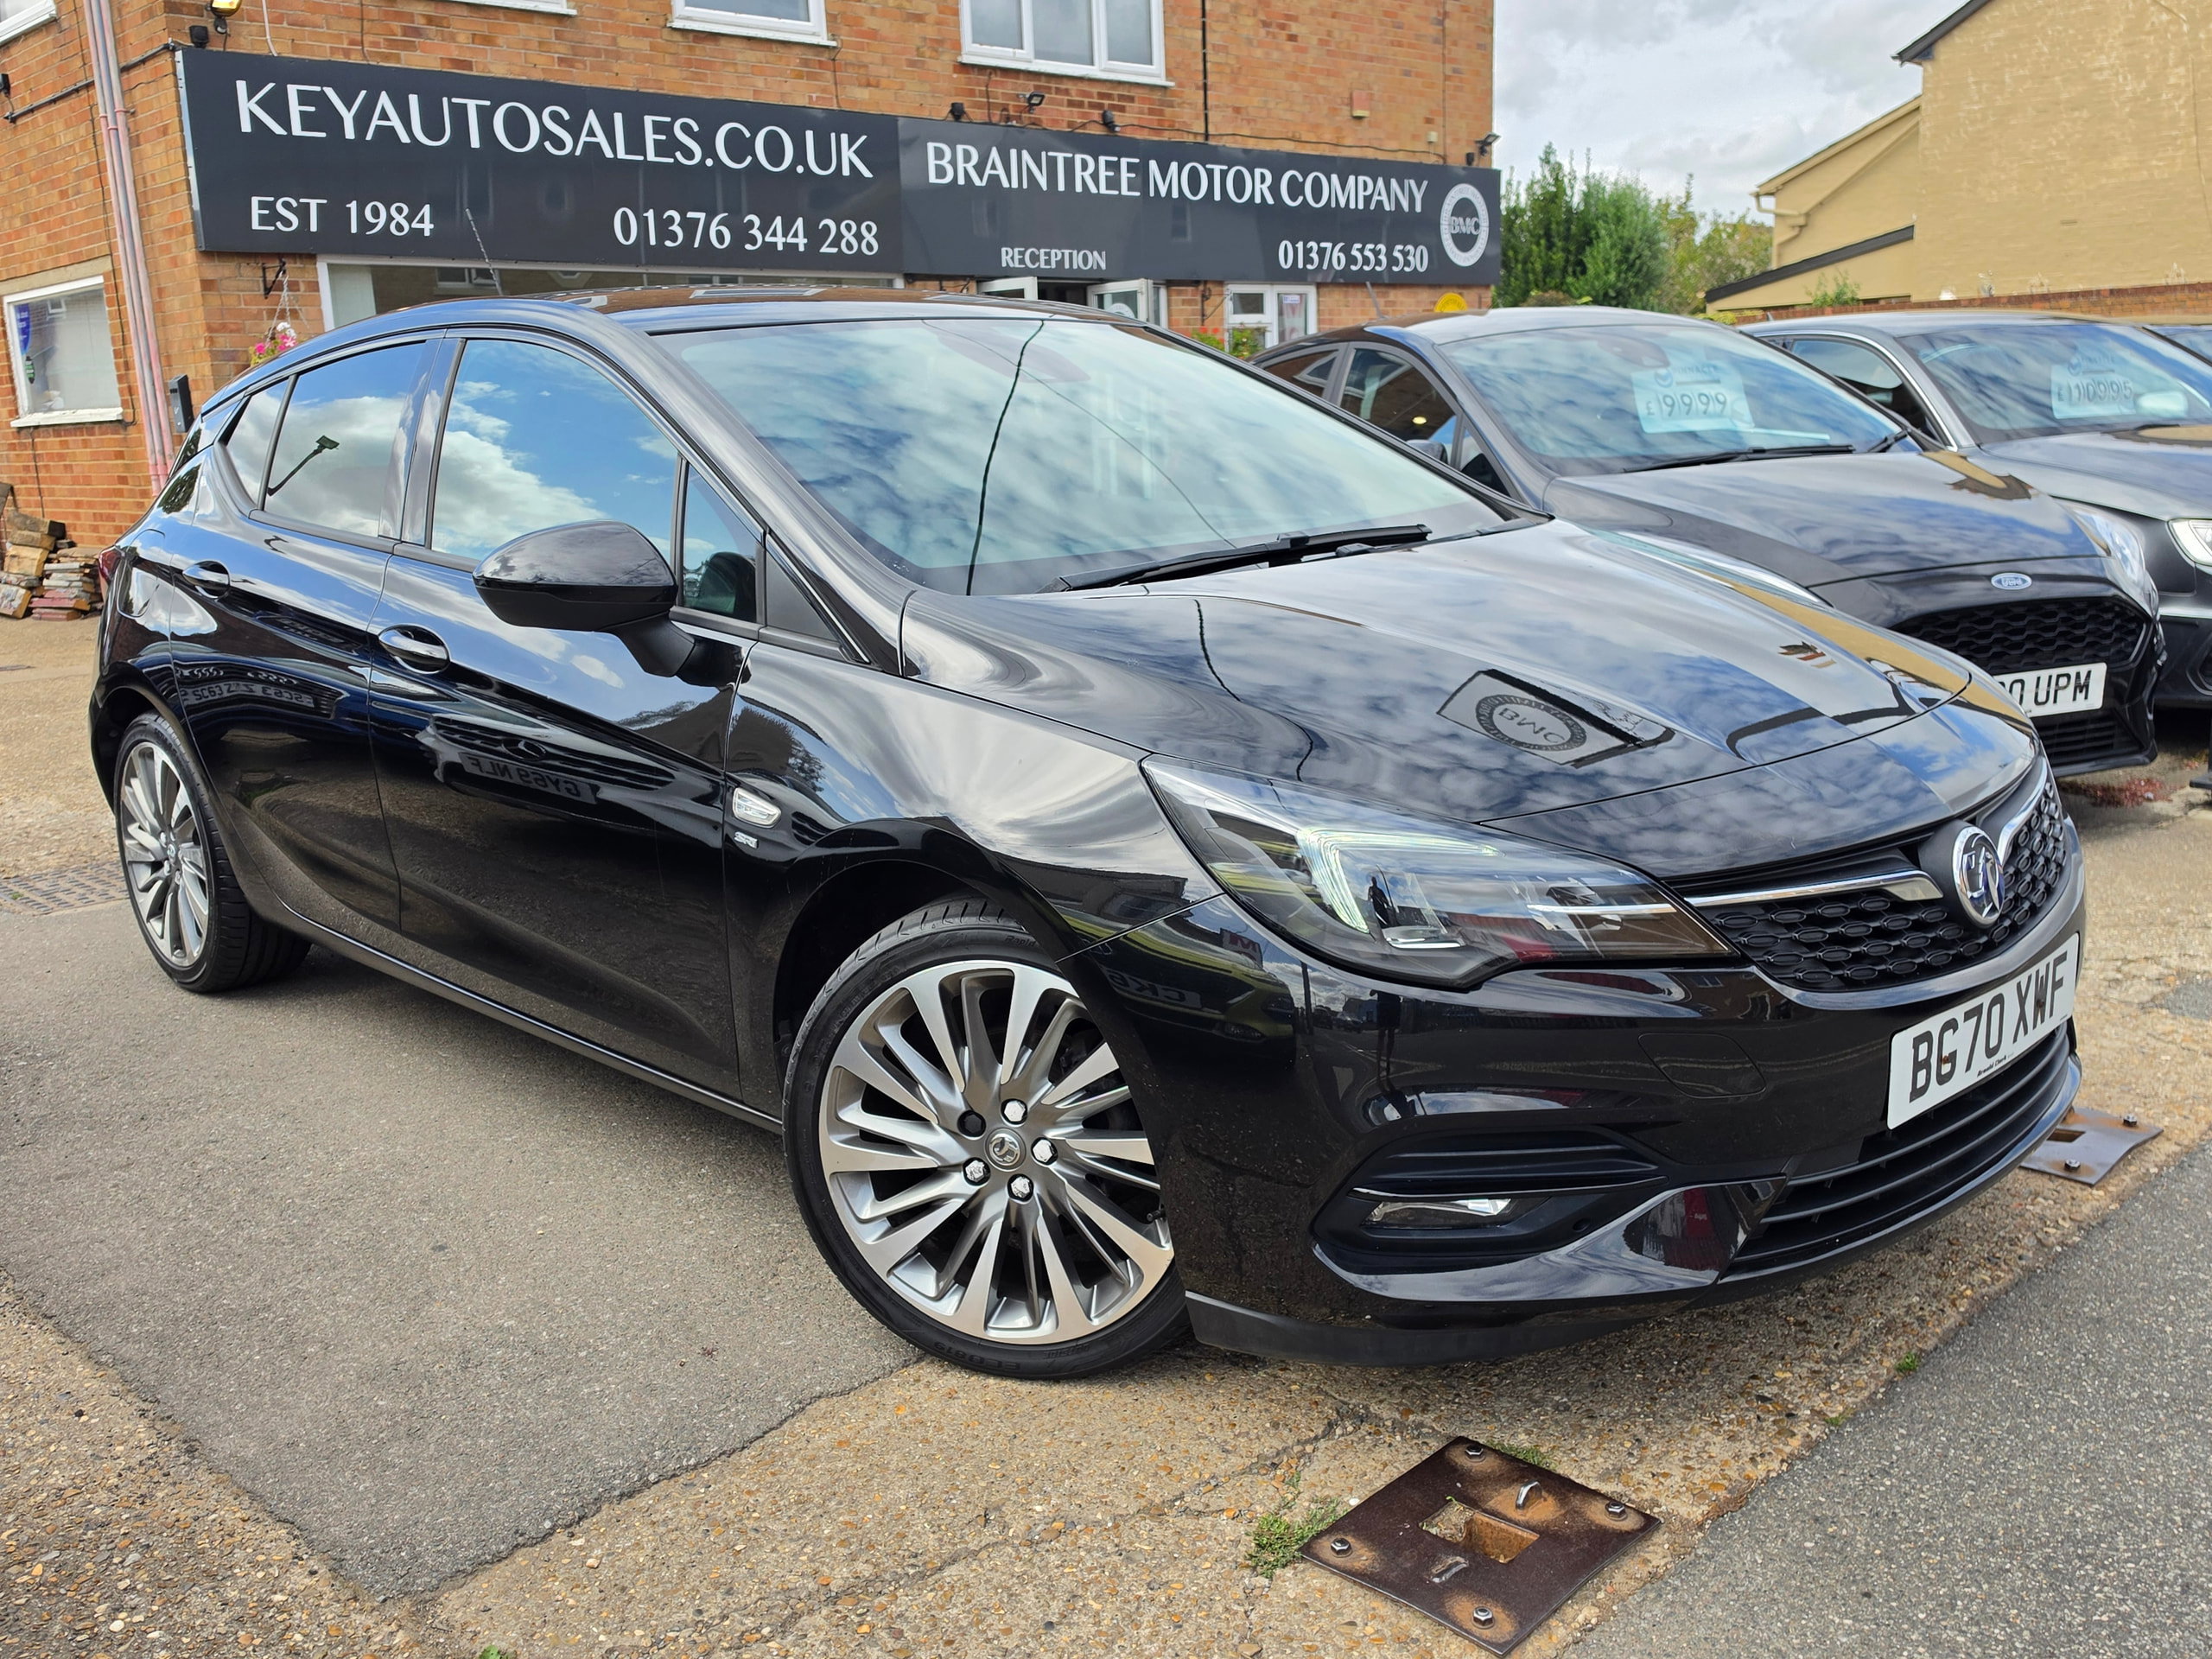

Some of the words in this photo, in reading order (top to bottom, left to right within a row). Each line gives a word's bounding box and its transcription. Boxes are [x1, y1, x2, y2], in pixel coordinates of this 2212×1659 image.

[235, 79, 874, 178] KEYAUTOSALES.CO.UK
[926, 142, 1141, 197] BRAINTREE
[1148, 159, 1275, 205] MOTOR
[1280, 169, 1428, 213] COMPANY
[251, 195, 327, 232] EST
[345, 200, 435, 237] 1984
[613, 207, 731, 250] 01376
[743, 213, 808, 252] 344
[818, 218, 879, 256] 288
[1450, 216, 1480, 235] BMC
[1001, 246, 1107, 270] RECEPTION
[1278, 239, 1346, 270] 01376
[1350, 243, 1388, 271] 553
[1391, 244, 1429, 273] 530
[2033, 669, 2092, 706] UPM
[1909, 992, 2005, 1103] BG70
[2012, 950, 2069, 1045] XWF
